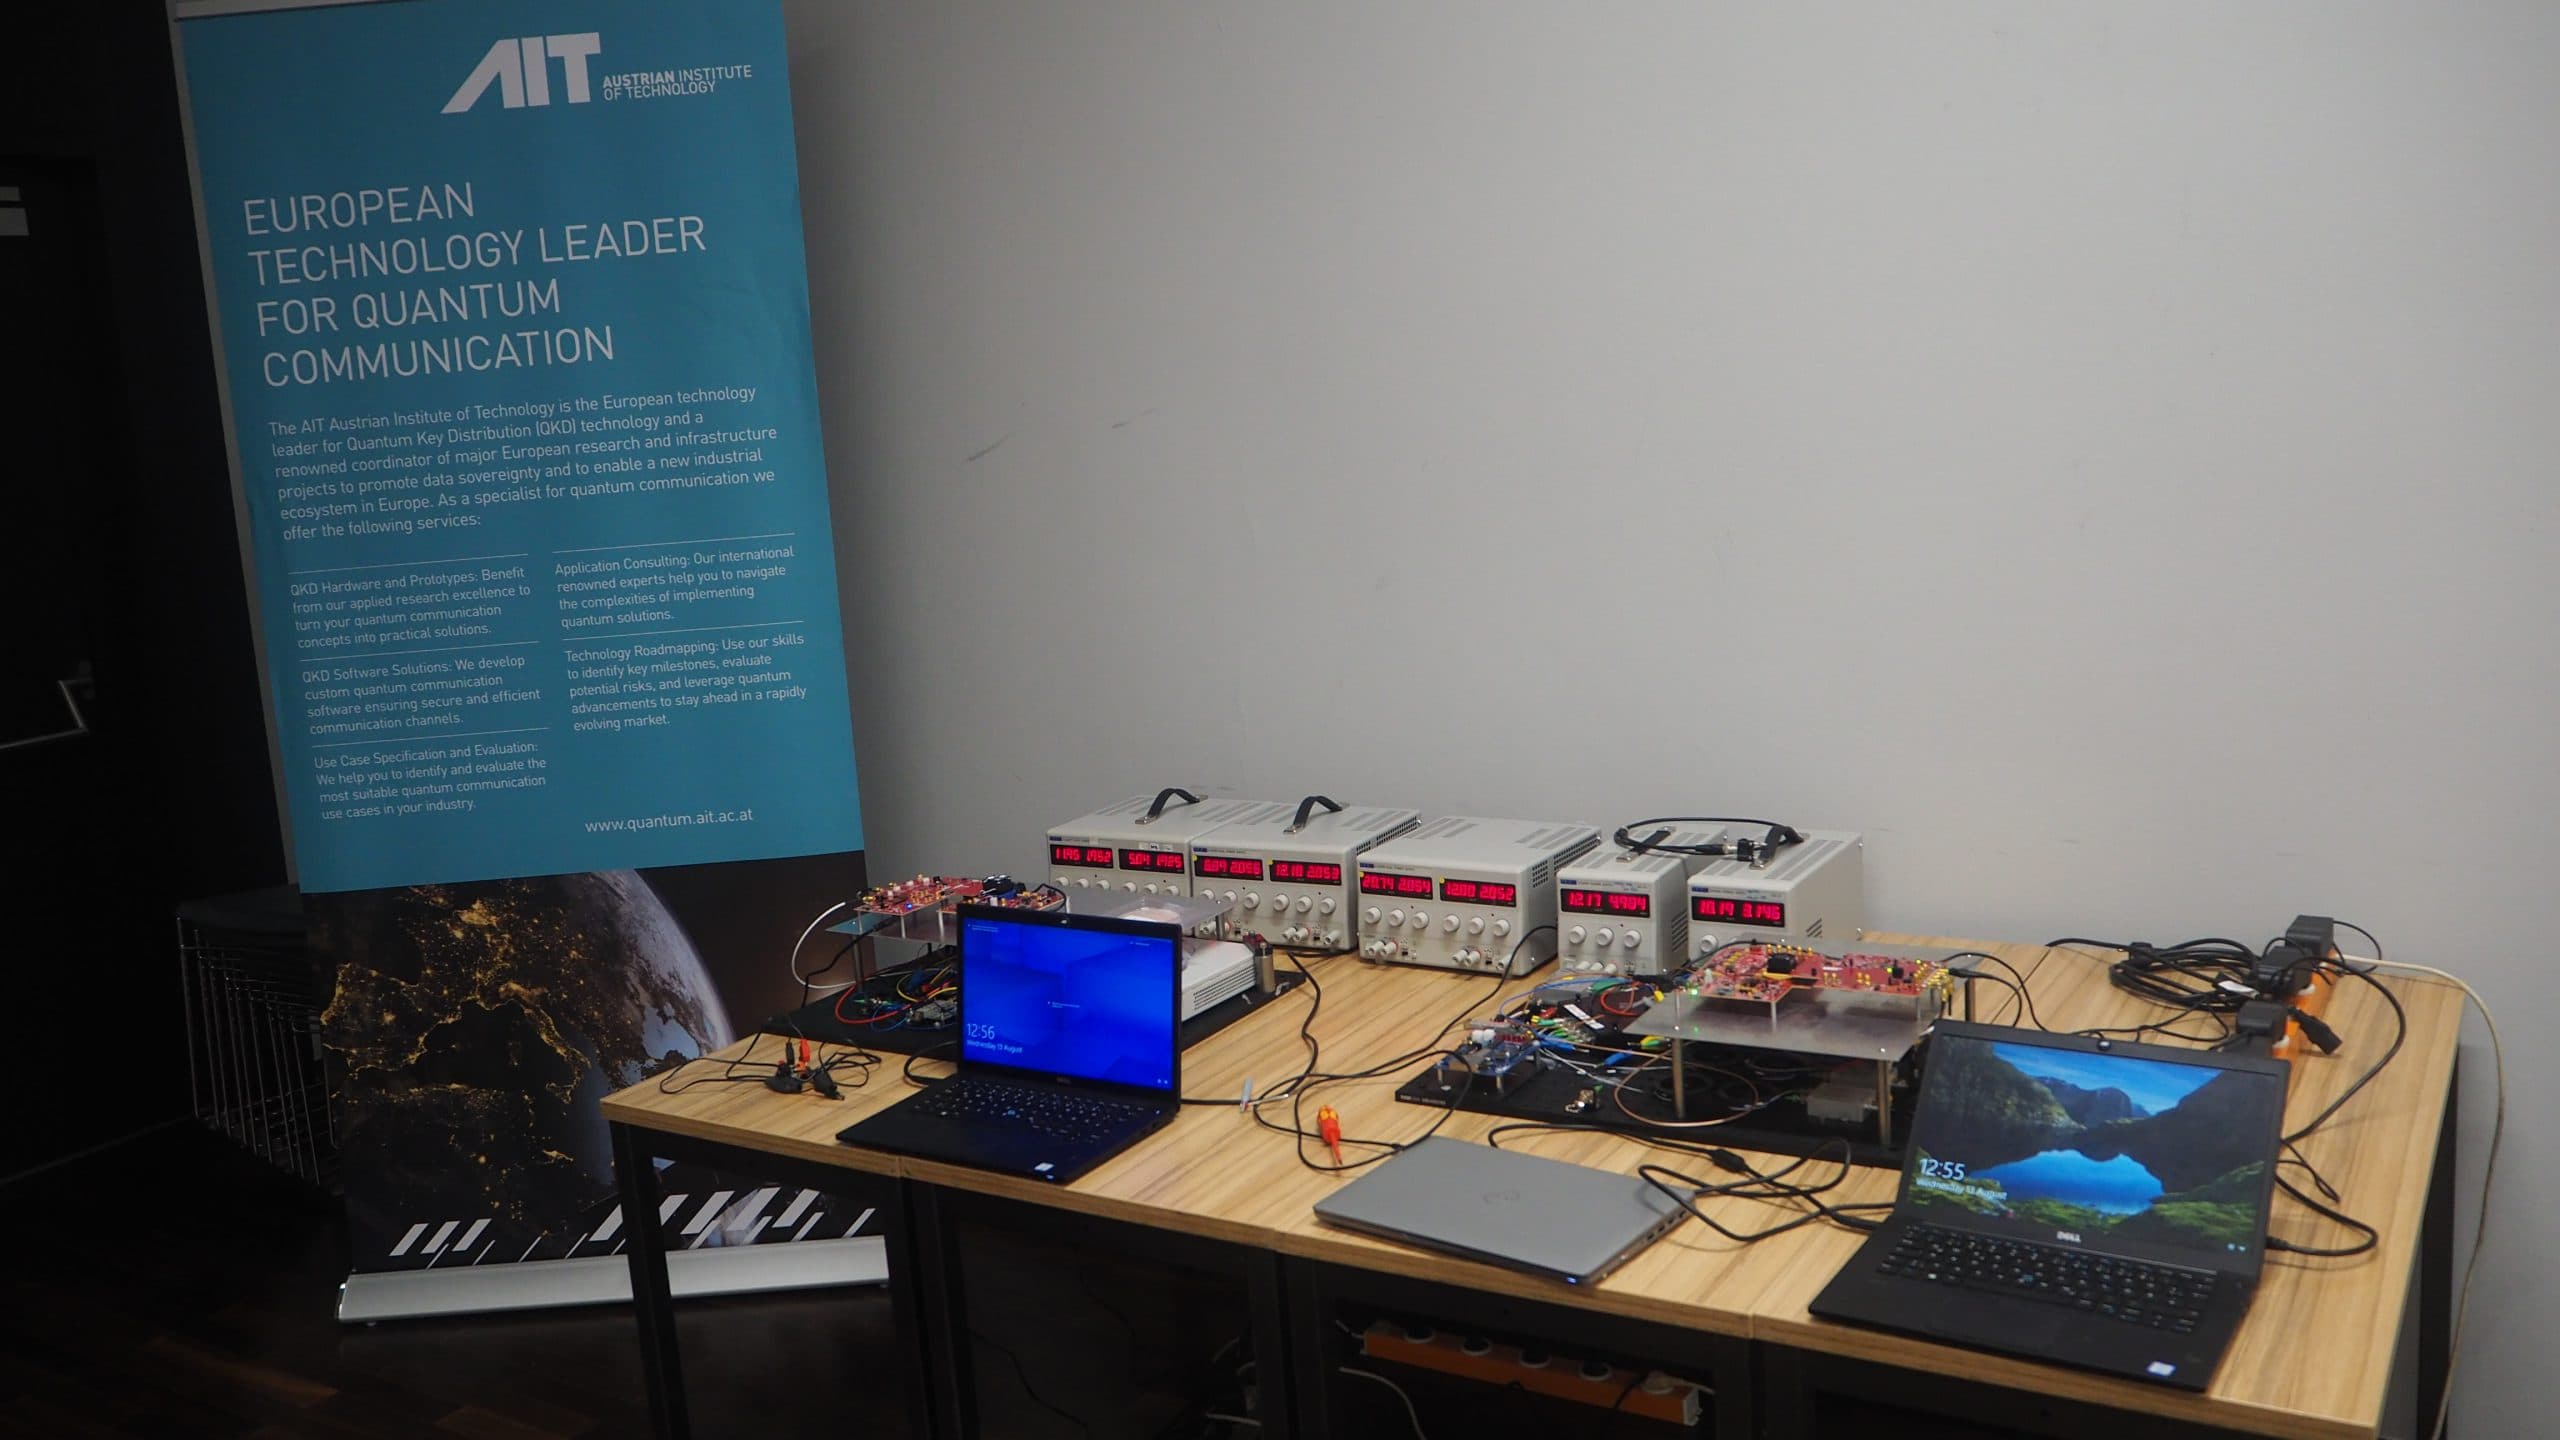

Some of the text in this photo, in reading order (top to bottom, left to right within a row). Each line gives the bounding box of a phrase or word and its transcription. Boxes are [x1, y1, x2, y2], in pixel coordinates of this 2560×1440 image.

[440, 32, 601, 114] AIT
[602, 64, 752, 88] AUSTRIAN INSTITUTE
[603, 80, 716, 101] OF TECHNOLOGY
[243, 181, 474, 235] EUROPEAN
[247, 215, 706, 286] TECHNOLOGY LEADER
[256, 278, 560, 336] FOR QUANTUM
[263, 325, 613, 387] COMMUNICATION
[268, 386, 756, 435] The AIT Austrian Institute of Technology is the European technology
[272, 410, 703, 456] leader for Quantum Key Distribution (QKD) technology and a
[275, 427, 777, 478] renowned coordinator of major European research and infrastructure
[278, 447, 763, 502] projects to promote data sovereignty and to enable a new industrial
[280, 470, 775, 520] ecosystem in Europe. As a specialist for quantum communication we
[283, 512, 480, 540] offer the following services:
[554, 544, 795, 577] Application Consulting: Our international
[290, 566, 525, 596] QKD Hardware and Prototypes: Benefit
[557, 565, 786, 592] renowned experts help you to navigate
[292, 584, 530, 613] from our applied research excellence to
[559, 585, 755, 610] the complexities of implementing
[294, 604, 501, 632] turn your quantum communication
[560, 609, 674, 630] quantum solutions.
[564, 633, 804, 661] Technology Roadmapping: Use our skills
[302, 655, 525, 683] QKD Software Solutions: We develop
[567, 654, 772, 680] to identify key milestones, evaluate
[304, 674, 503, 700] custom quantum communication
[569, 671, 791, 700] potential risks, and leverage quantum
[571, 684, 806, 714] advancements to stay ahead in a rapidly
[306, 688, 541, 718] software ensuring secure and efficient
[309, 712, 464, 735] communication channels.
[573, 713, 670, 731] evolving market.
[584, 808, 753, 832] www.quantum.ait.ac.at
[967, 1024, 995, 1040] 12:56
[1920, 1159, 1965, 1181] 12:55
[1976, 1187, 2007, 1201] August
